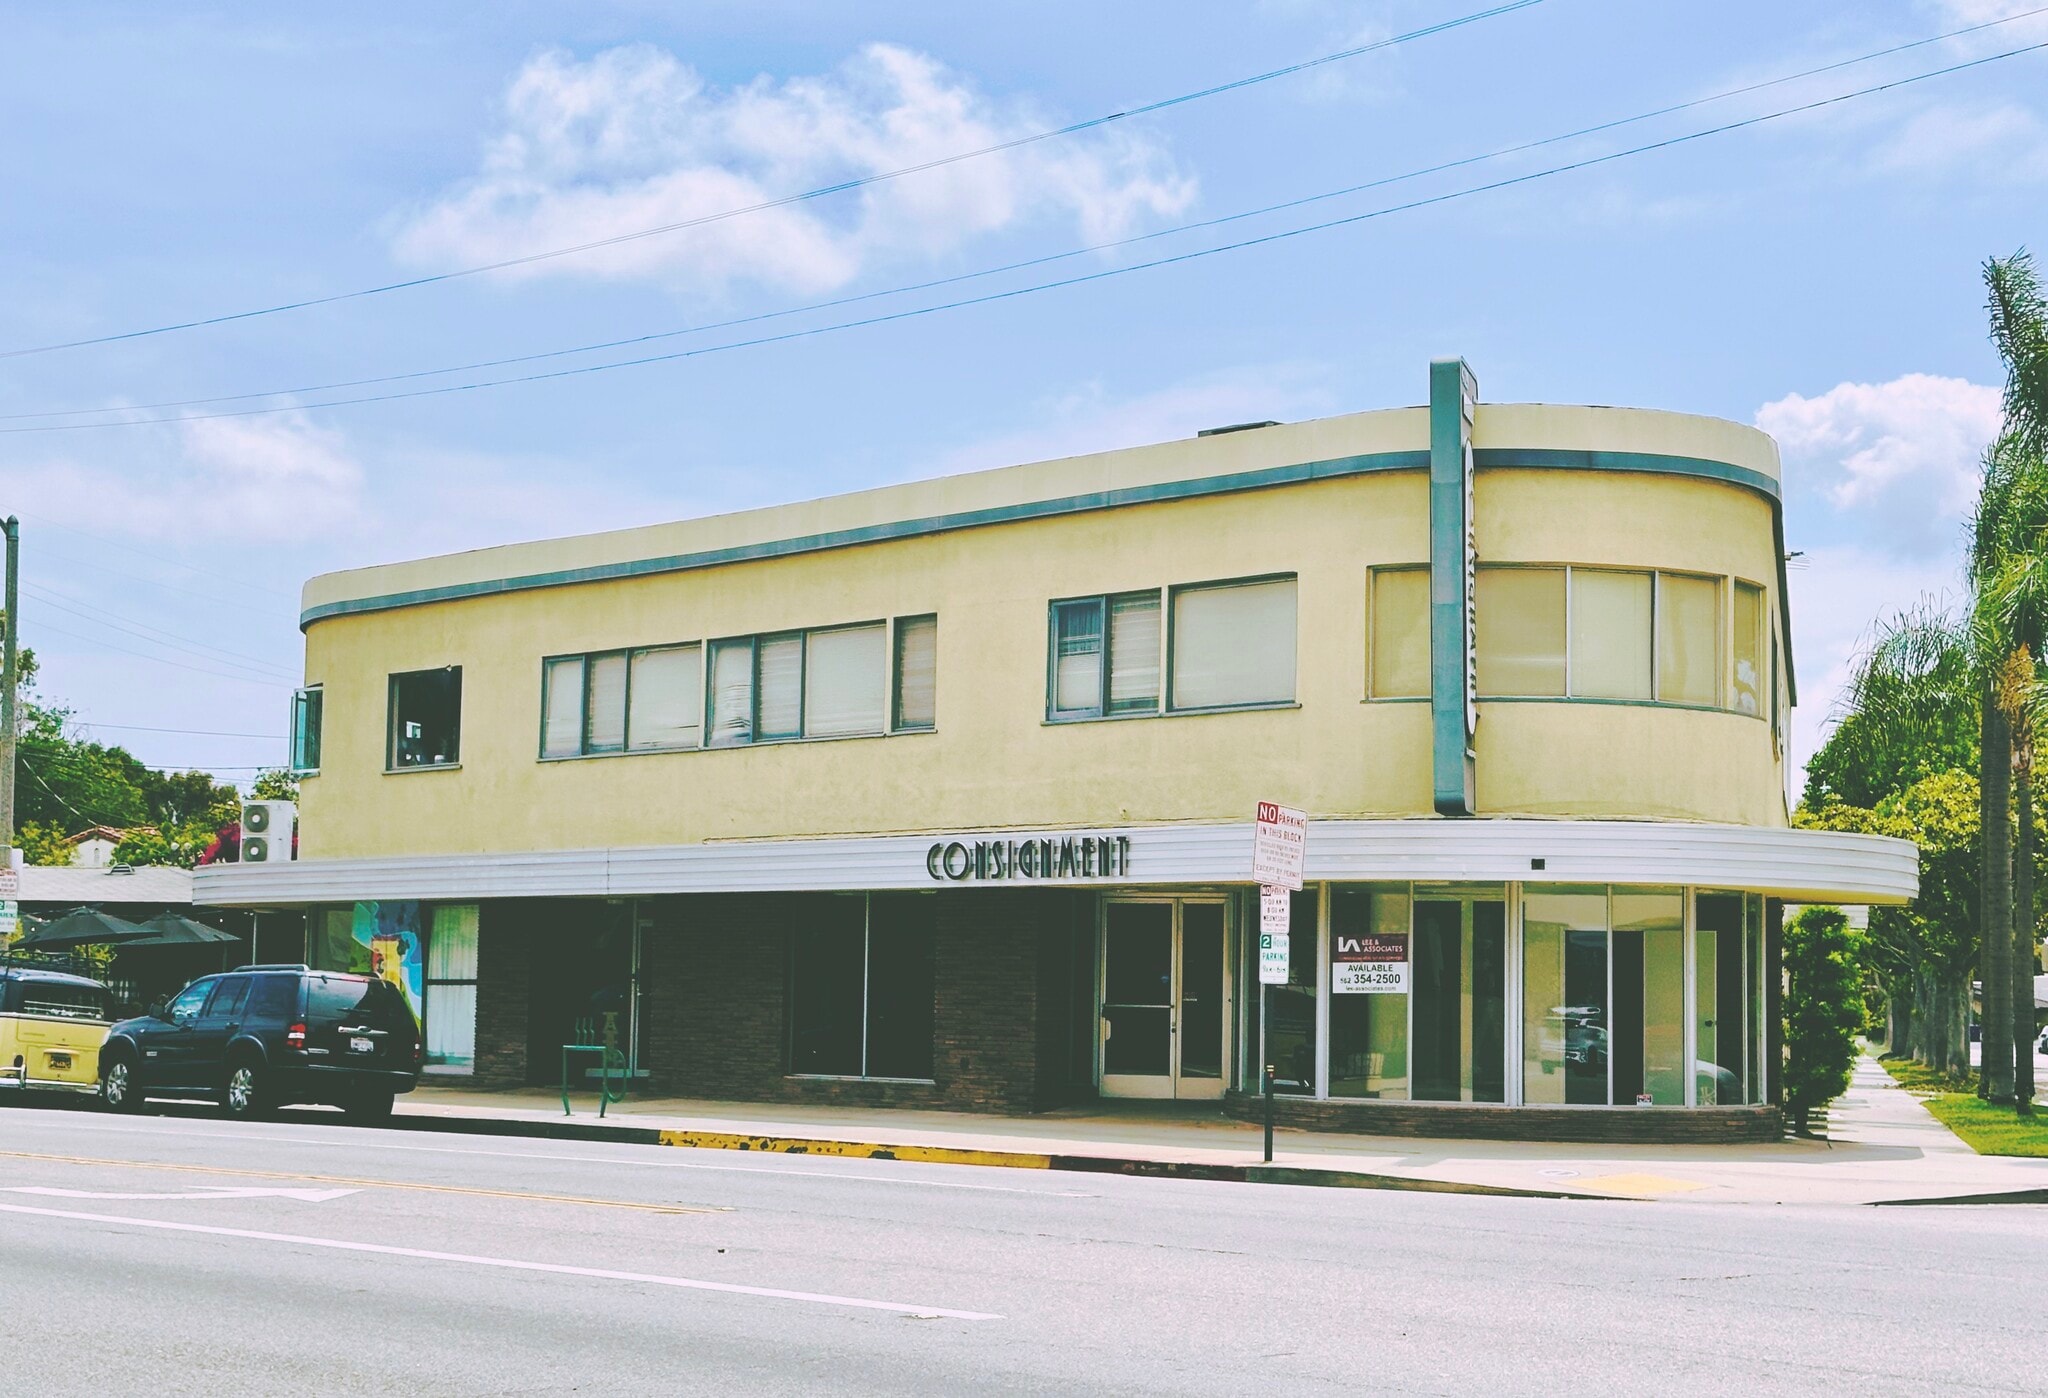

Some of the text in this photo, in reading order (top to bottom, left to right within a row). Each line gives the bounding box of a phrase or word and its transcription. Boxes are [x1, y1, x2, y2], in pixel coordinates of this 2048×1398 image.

[1260, 804, 1304, 828] NO PARKING
[1260, 825, 1302, 843] IN THIS BLOCK
[926, 835, 1130, 881] CONSIGNMENT
[1262, 936, 1287, 948] 2 HOUR
[1262, 952, 1287, 961] PARKING
[1348, 964, 1393, 972] AVAILABLE
[1354, 974, 1401, 984] 354-2500
